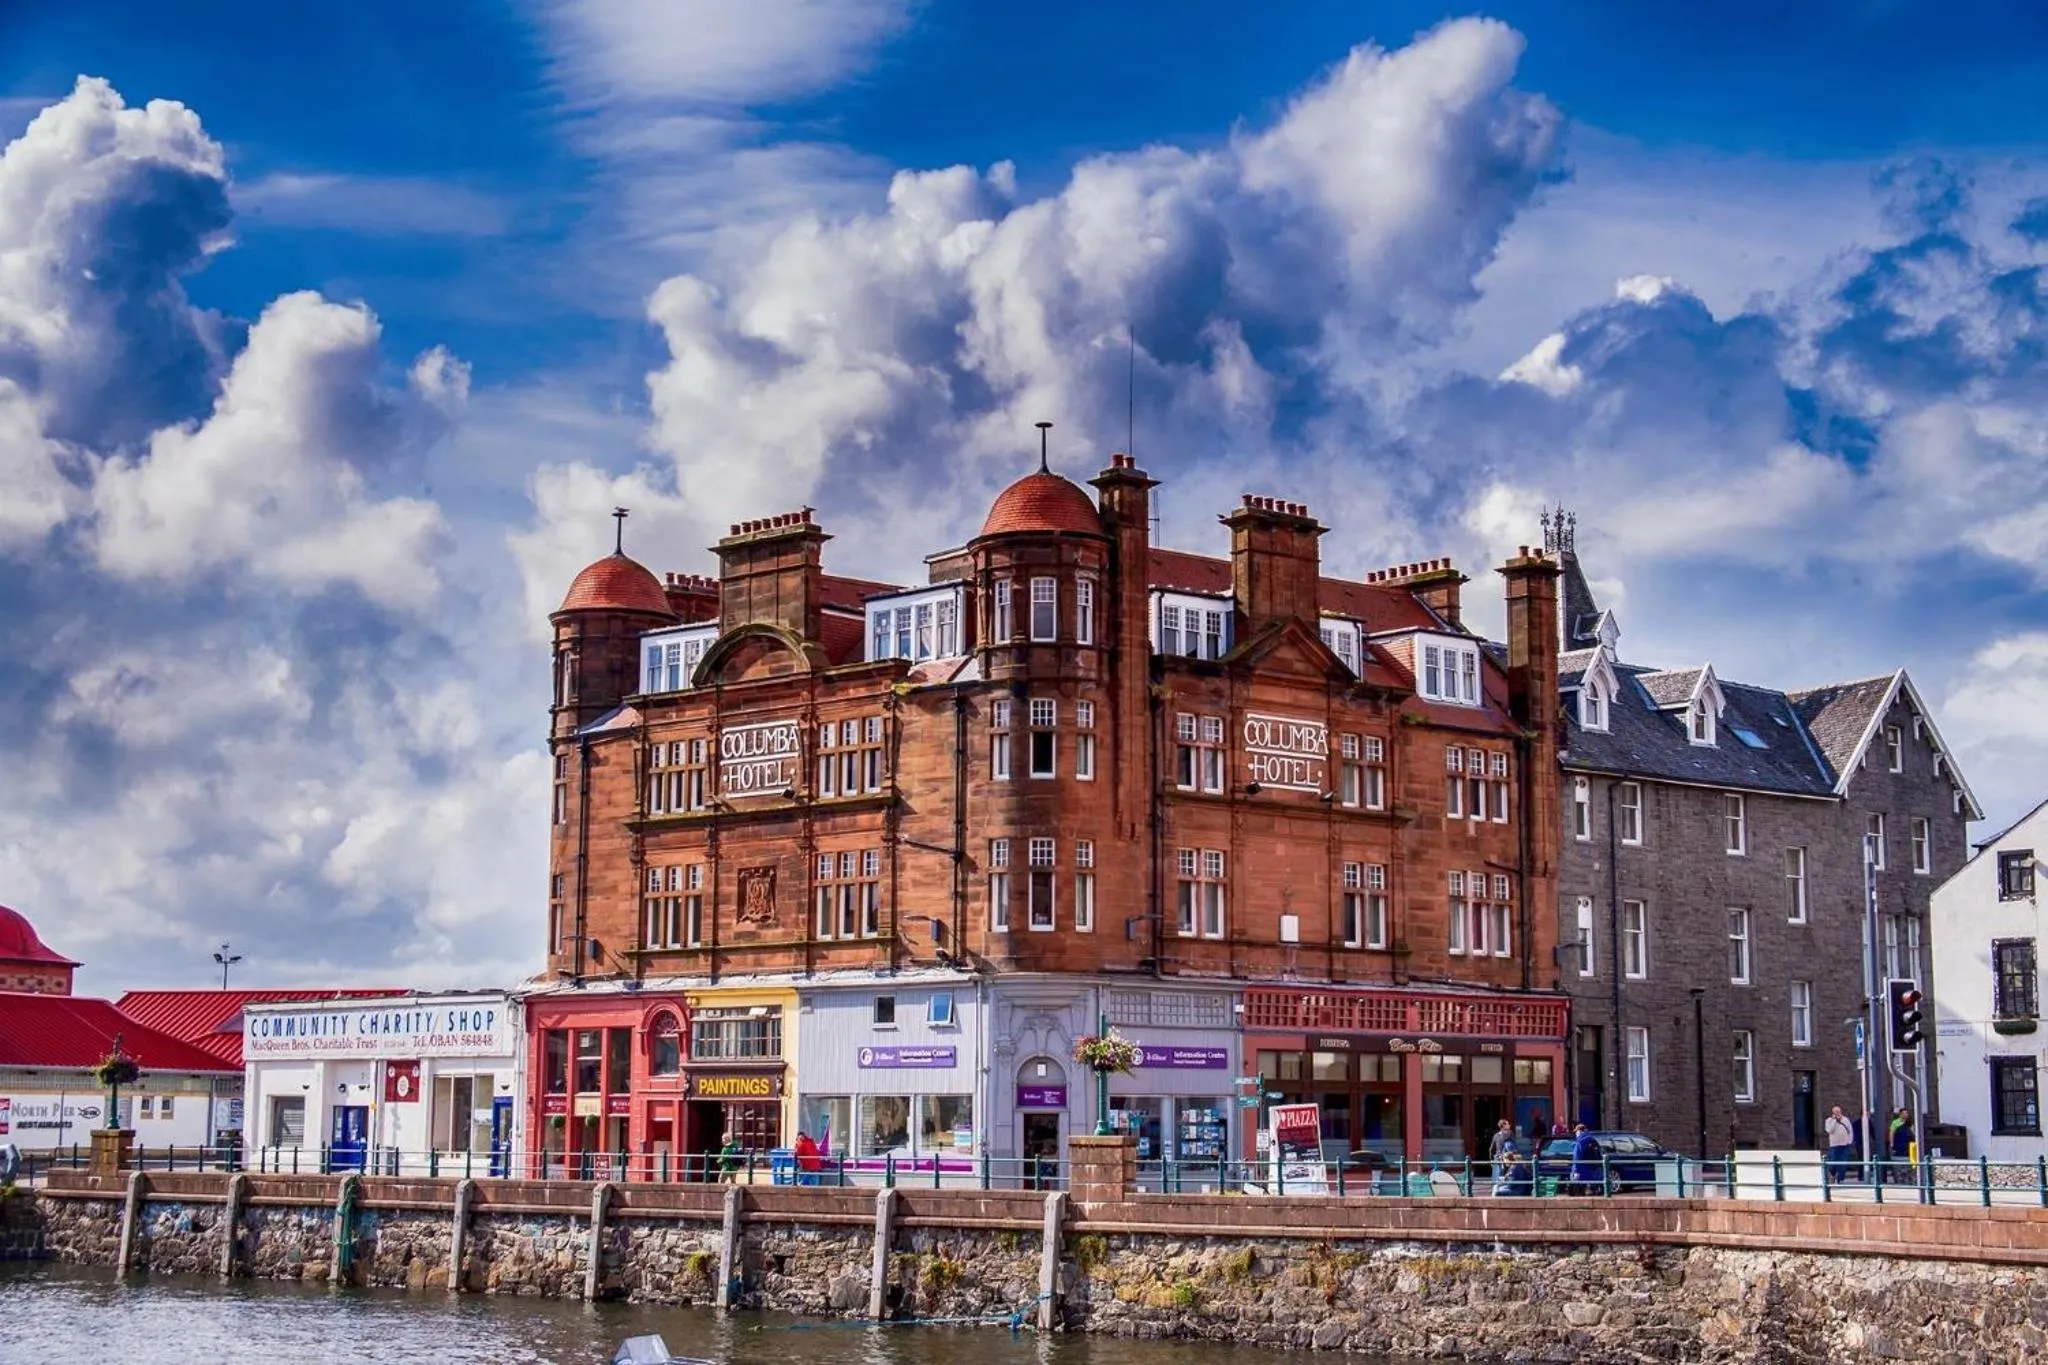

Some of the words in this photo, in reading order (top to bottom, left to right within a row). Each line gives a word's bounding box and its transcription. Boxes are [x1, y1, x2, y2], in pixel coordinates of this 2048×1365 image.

[721, 725, 800, 758] COLUMBA
[1244, 720, 1329, 754] COLUMBA
[728, 760, 792, 792] HOTEL
[1253, 755, 1320, 786] HOTEL
[251, 1015, 349, 1037] COMMUNITY
[359, 1011, 432, 1034] CHARITY
[448, 1010, 494, 1031] SHOP
[251, 1040, 290, 1052] MacQueen
[313, 1038, 353, 1050] Charitable
[356, 1036, 378, 1049] Trust
[429, 1034, 458, 1047] OBAN
[460, 1034, 494, 1046] 564848
[698, 1078, 770, 1095] PAINTINGS
[53, 1103, 75, 1117] PER
[1286, 1110, 1317, 1127] PIAZZA
